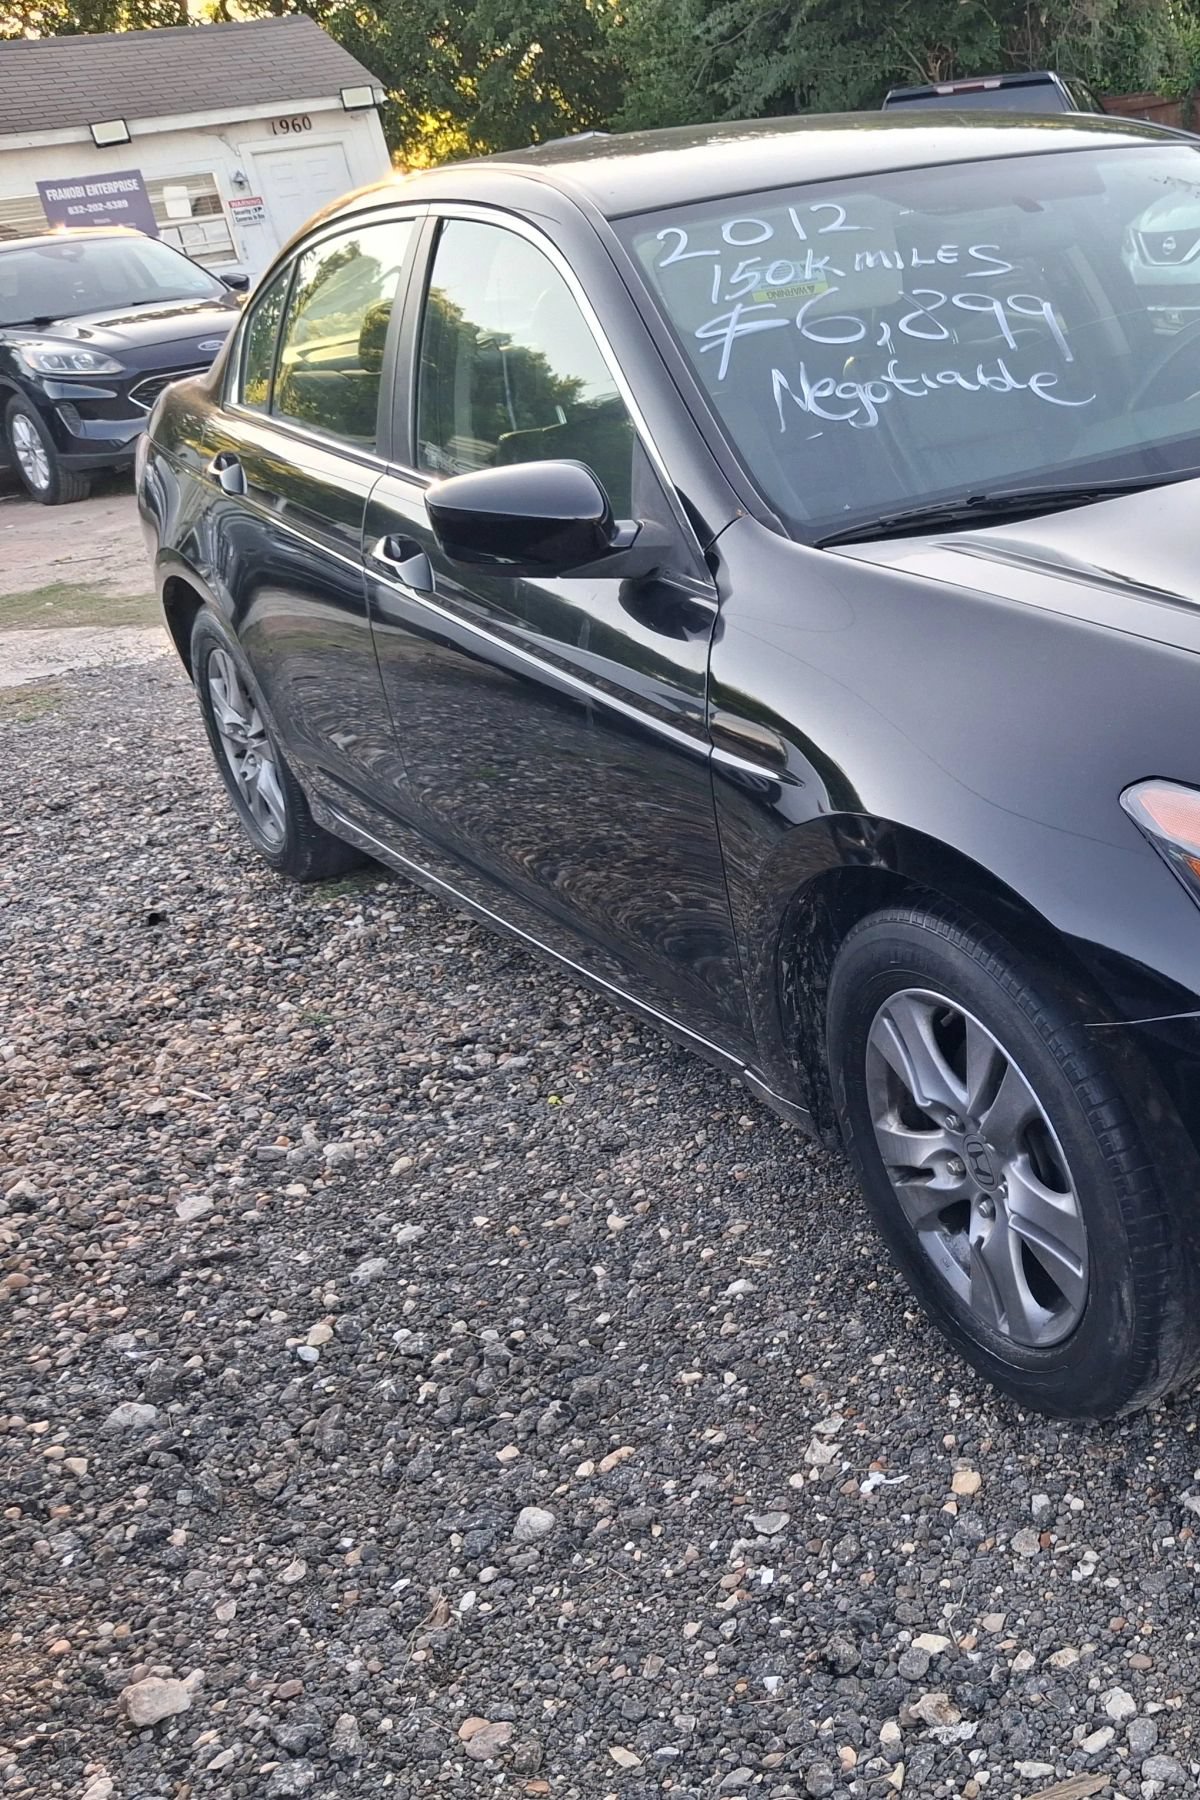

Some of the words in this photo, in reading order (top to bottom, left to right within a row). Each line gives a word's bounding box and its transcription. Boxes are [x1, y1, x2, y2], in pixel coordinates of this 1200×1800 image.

[271, 116, 312, 135] 1960
[45, 185, 86, 202] FRANOBI
[85, 179, 140, 197] ENTERPRISE
[656, 203, 873, 268] 2012
[854, 244, 1018, 278] MILES
[766, 286, 808, 299] WARNING
[694, 287, 1075, 381] $6,899
